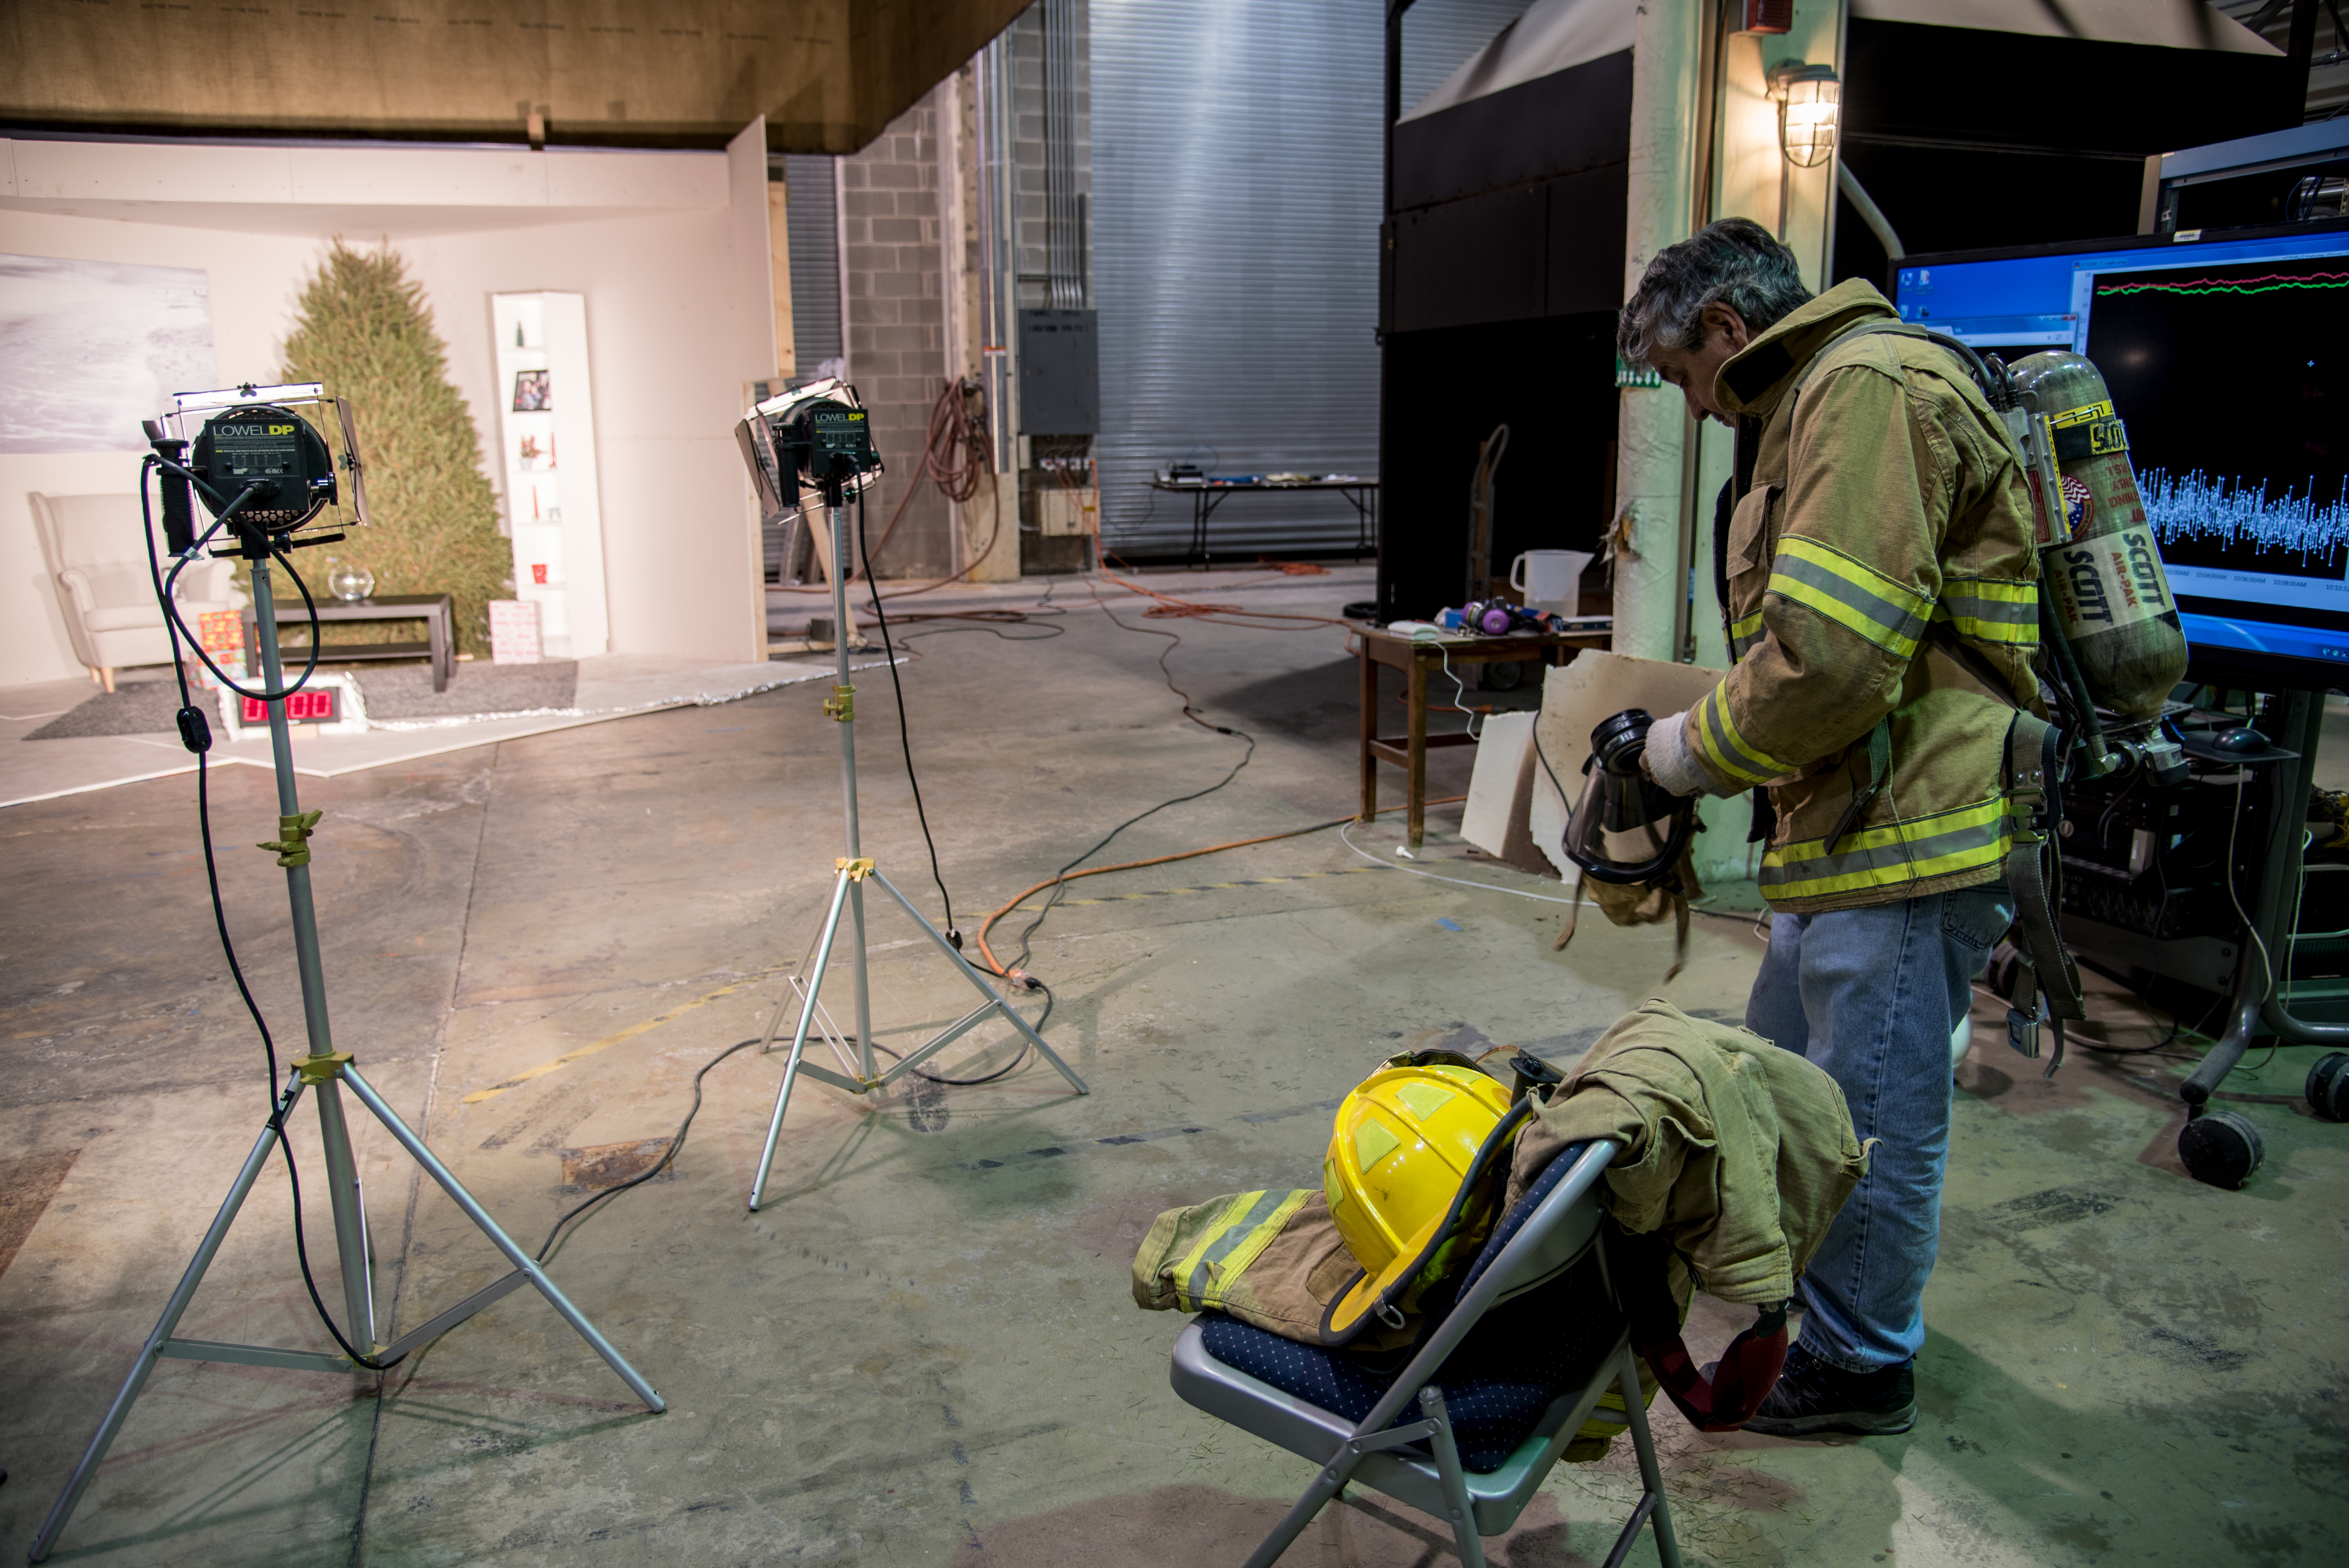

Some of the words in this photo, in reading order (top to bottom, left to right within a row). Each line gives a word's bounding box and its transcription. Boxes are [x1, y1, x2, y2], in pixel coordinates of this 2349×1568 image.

[2054, 570, 2078, 623] AIR-PAK
[2063, 551, 2114, 623] SCOTT
[2111, 552, 2138, 608] AIR-PAK
[2122, 533, 2165, 606] SCOTT
[2273, 579, 2307, 588] 10:08:00AM
